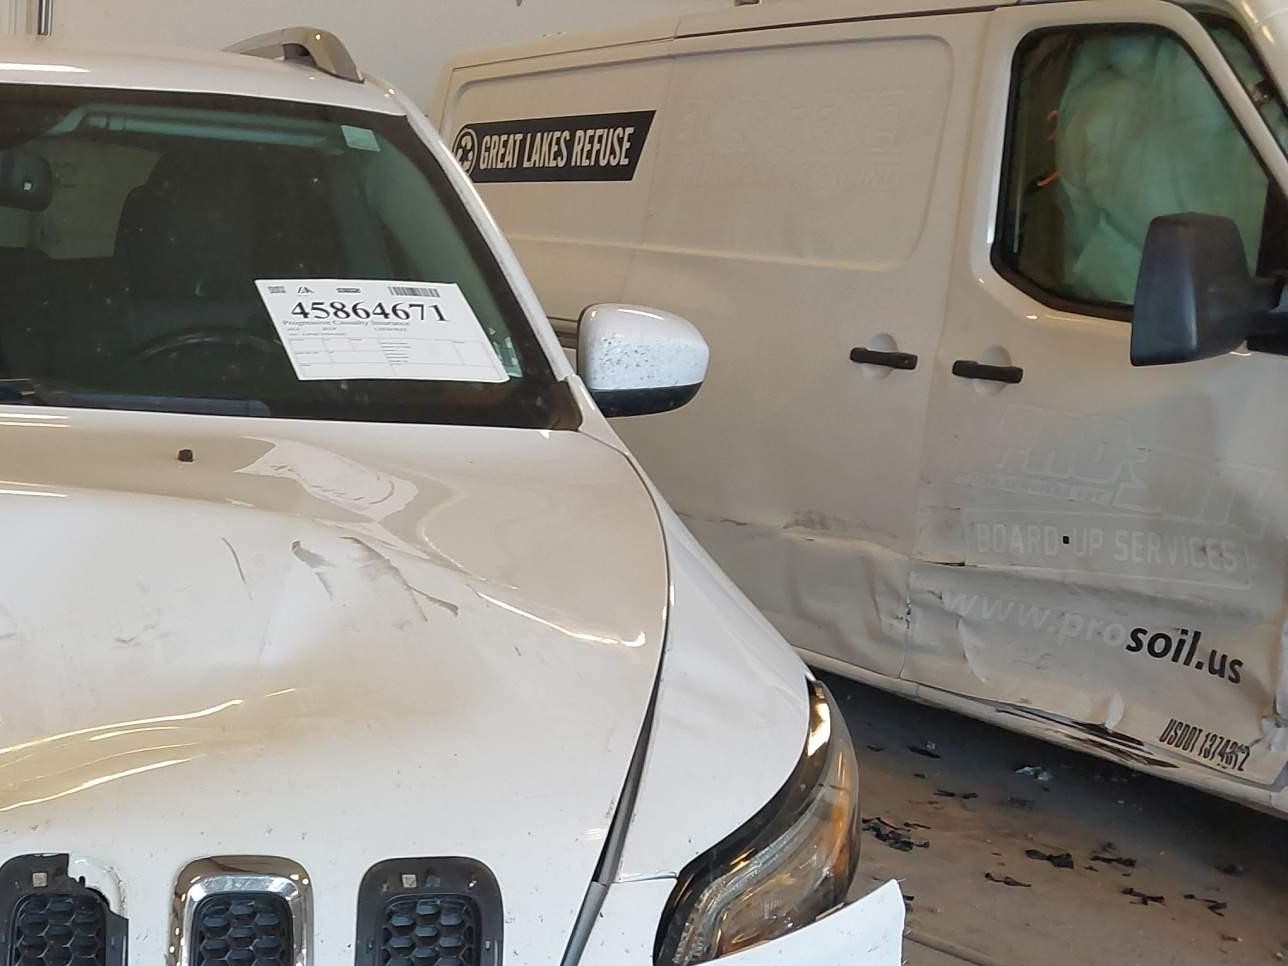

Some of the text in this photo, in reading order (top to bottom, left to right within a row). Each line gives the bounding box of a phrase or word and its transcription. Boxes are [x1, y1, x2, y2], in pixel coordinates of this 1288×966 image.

[479, 127, 634, 170] GREAT LAKES REFUSE
[291, 302, 448, 321] 45864671
[1114, 529, 1239, 573] SERVICES
[1159, 718, 1203, 752] USDOT
